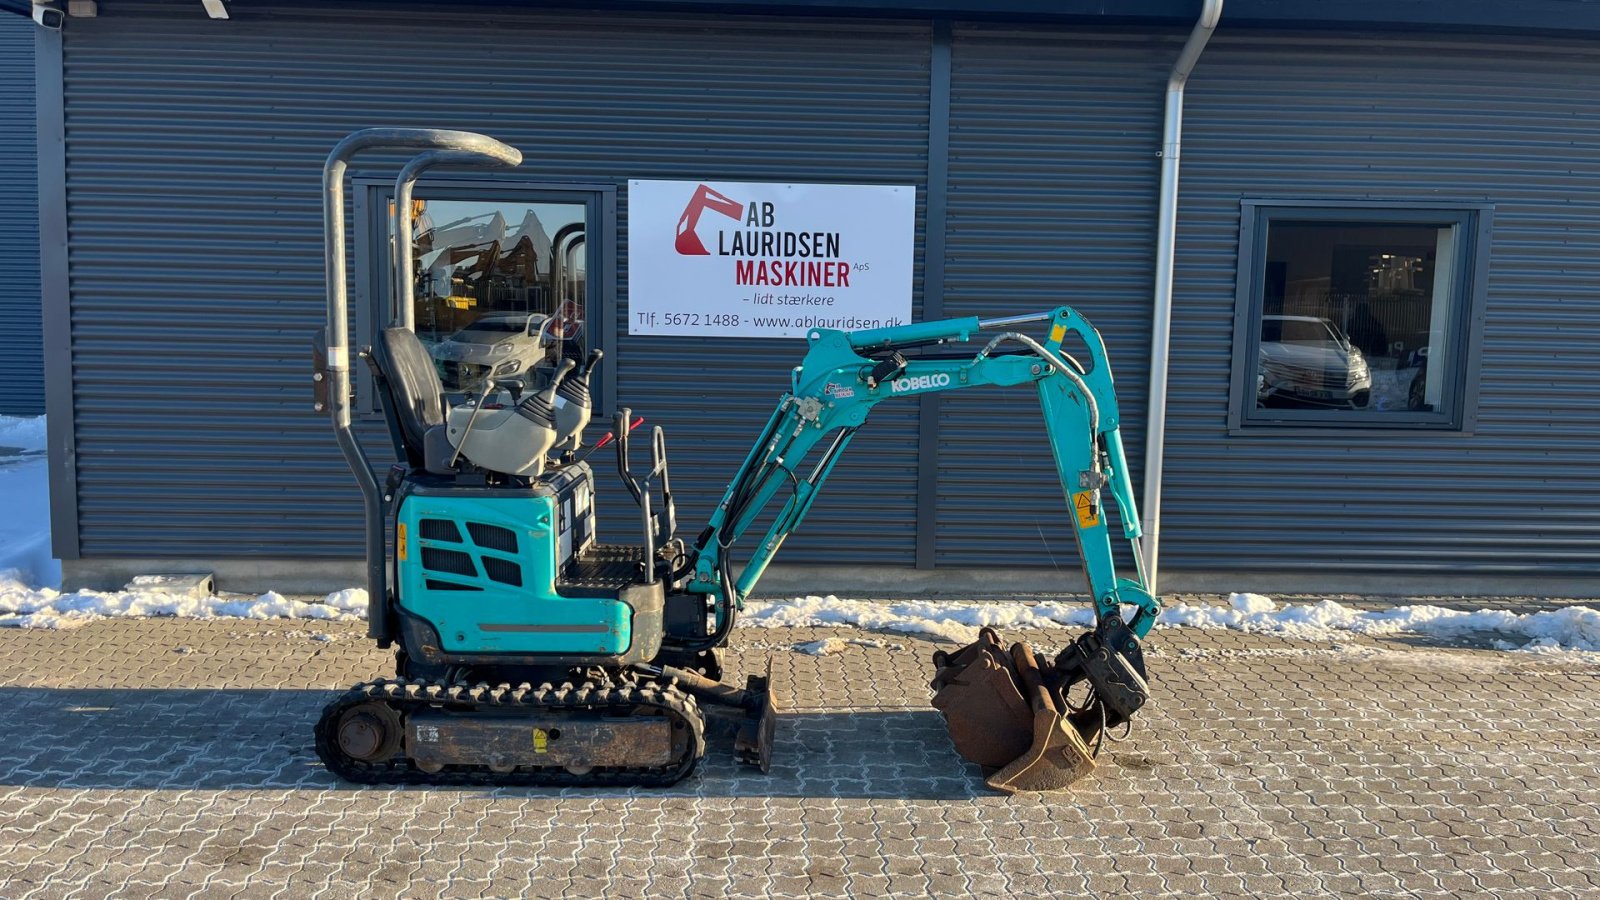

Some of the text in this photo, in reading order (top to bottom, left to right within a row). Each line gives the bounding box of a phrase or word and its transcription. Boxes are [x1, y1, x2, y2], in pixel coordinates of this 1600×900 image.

[746, 201, 775, 227] AB
[719, 230, 840, 258] LAURIDSEN
[736, 260, 870, 287] MASKINER ApS
[753, 293, 774, 305] lidt
[777, 294, 835, 306] stærkere
[637, 312, 659, 327] Tlf.
[664, 313, 700, 326] 5672
[704, 314, 740, 327] 1488
[891, 373, 950, 393] KOBELCO
